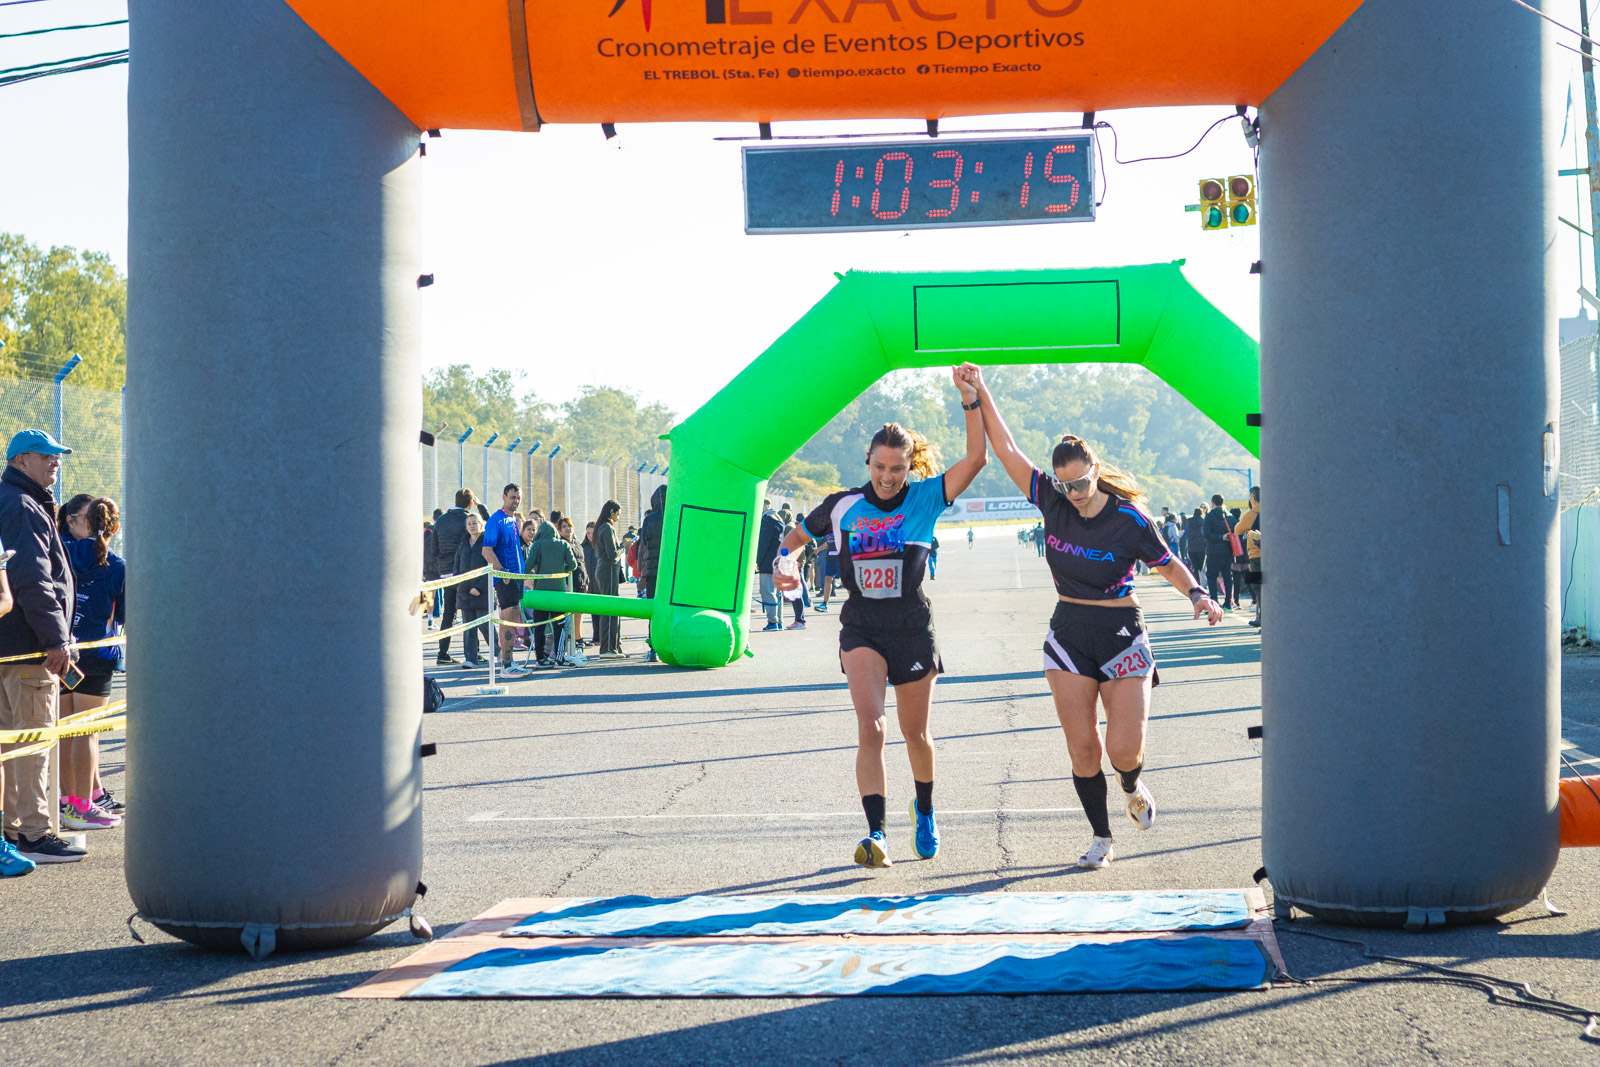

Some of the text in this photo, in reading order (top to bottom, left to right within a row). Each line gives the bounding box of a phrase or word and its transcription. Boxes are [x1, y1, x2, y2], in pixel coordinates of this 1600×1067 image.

[597, 29, 1084, 60] Cronometraje de Eventos Deportivos
[644, 62, 1042, 80] EL TREBOL (Sta. Fe) tiempo.exacto Tiempo Exacto
[1046, 534, 1116, 563] RUNNEA
[863, 567, 895, 589] 228
[1113, 652, 1147, 678] 223
